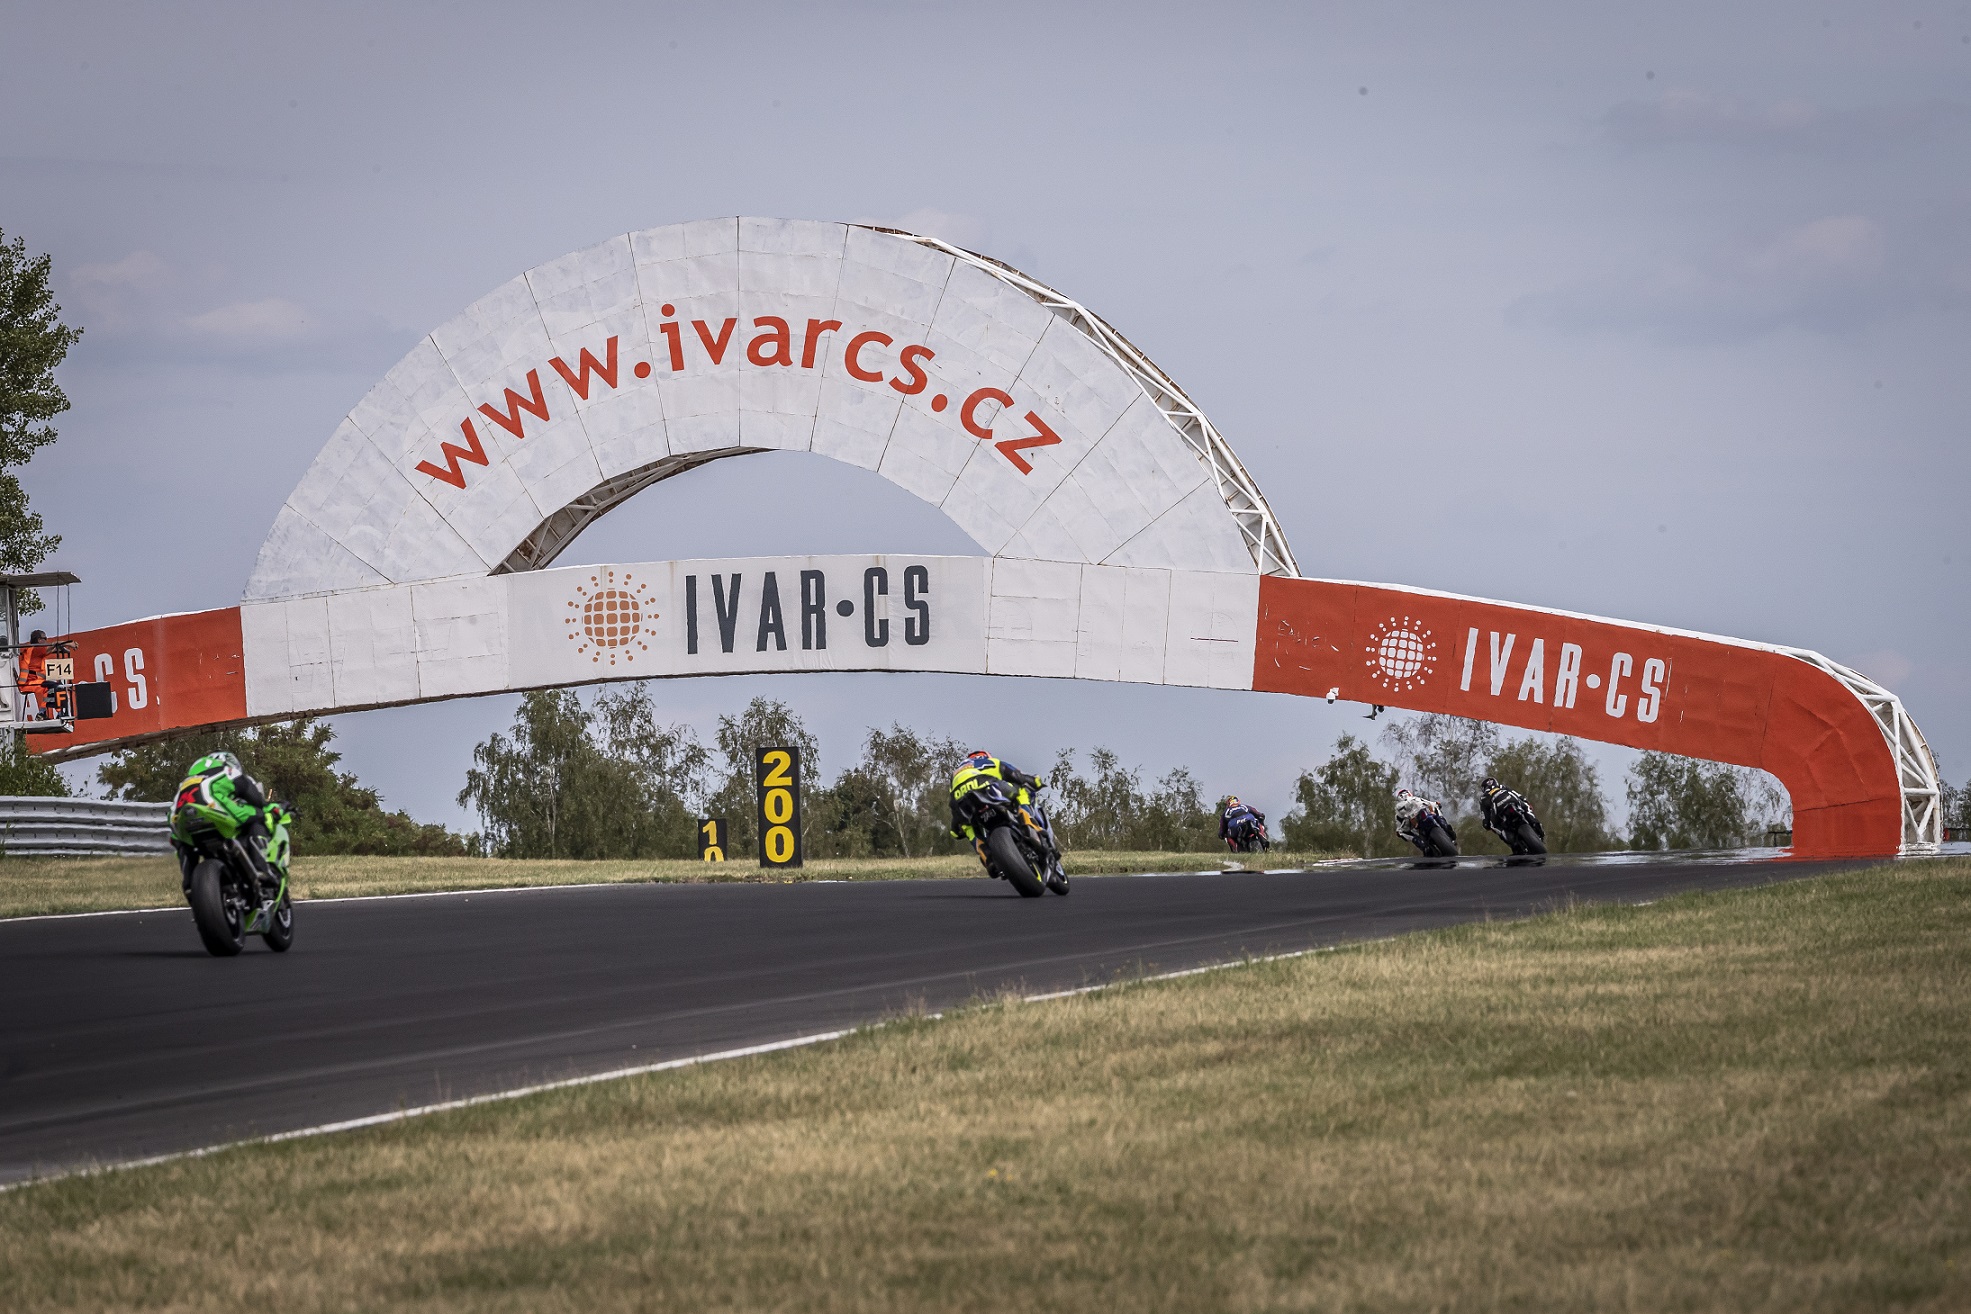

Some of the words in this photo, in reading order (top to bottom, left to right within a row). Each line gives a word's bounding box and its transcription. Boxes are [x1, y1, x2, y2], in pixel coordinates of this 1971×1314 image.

[414, 304, 1063, 490] www.ivarcs.cz
[46, 663, 72, 677] F14
[762, 750, 795, 863] 200
